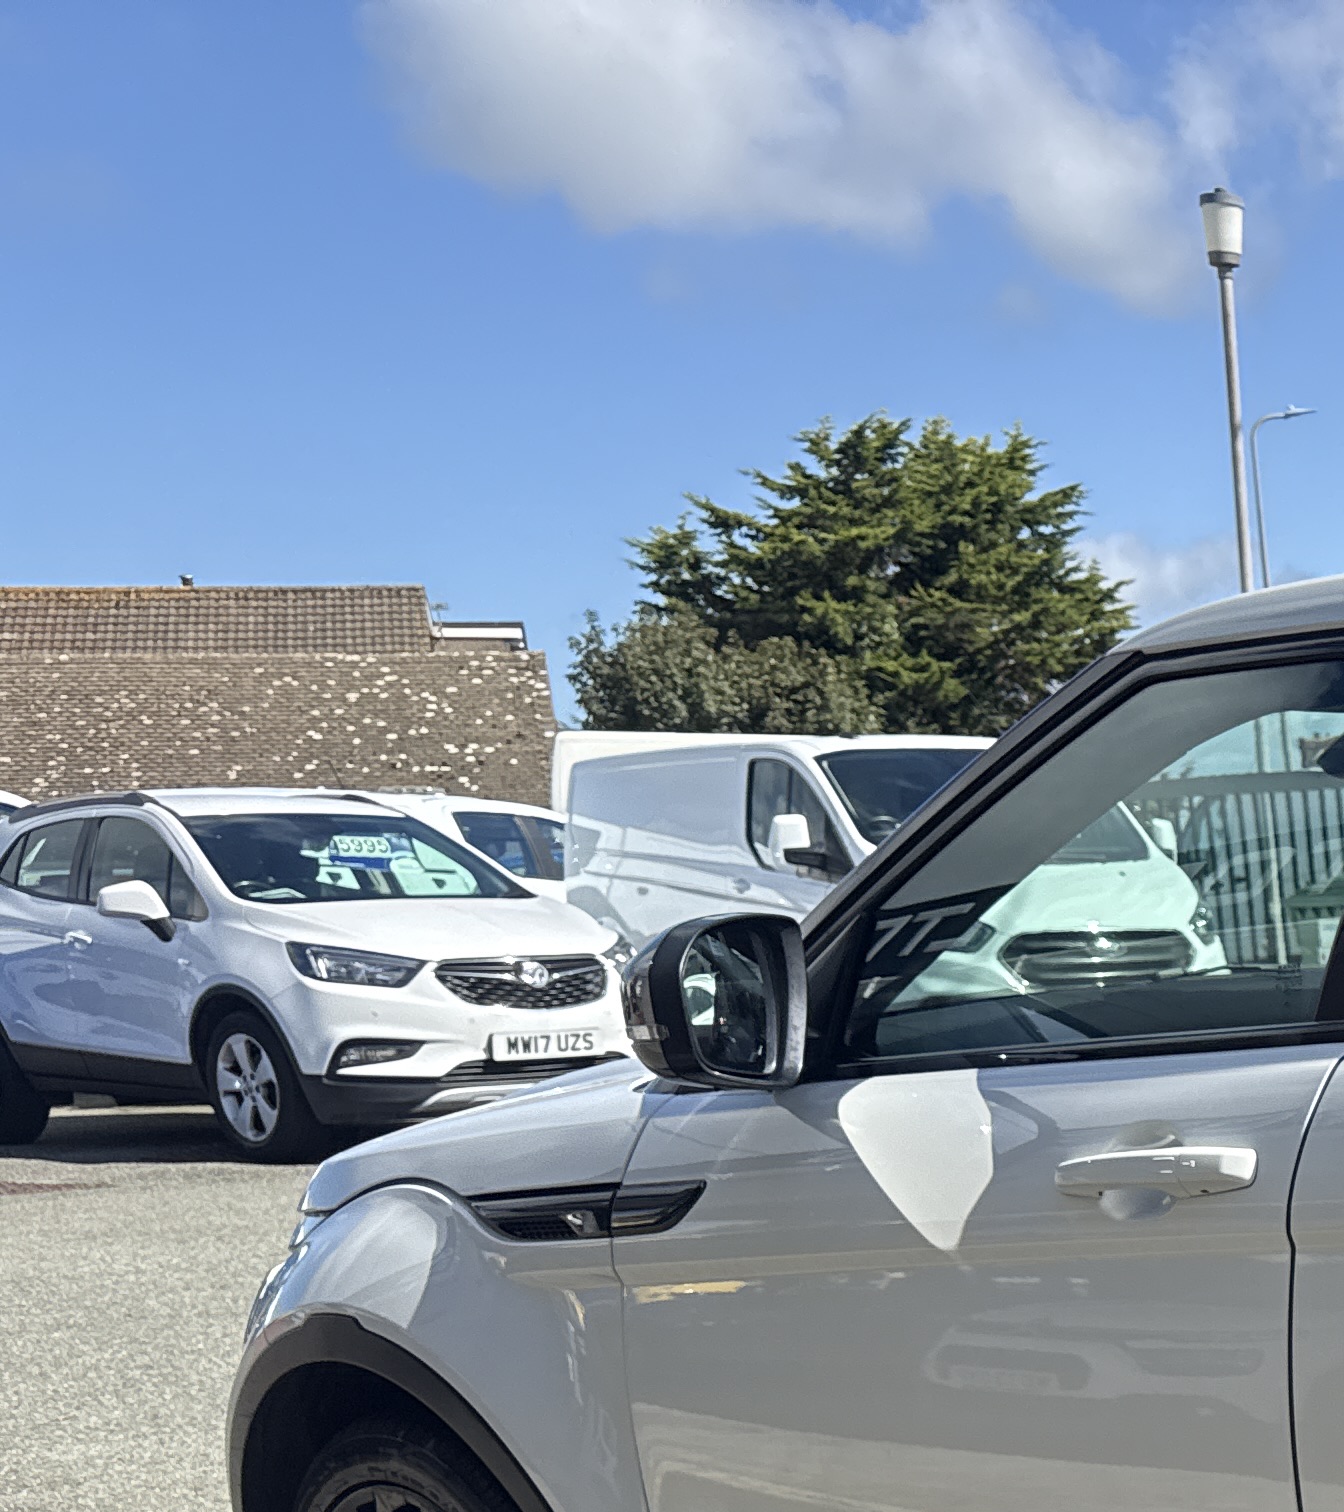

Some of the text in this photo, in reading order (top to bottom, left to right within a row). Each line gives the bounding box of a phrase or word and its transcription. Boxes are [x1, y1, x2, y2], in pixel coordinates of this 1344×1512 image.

[338, 838, 388, 853] 5995
[506, 1033, 594, 1055] MW17 UZS
